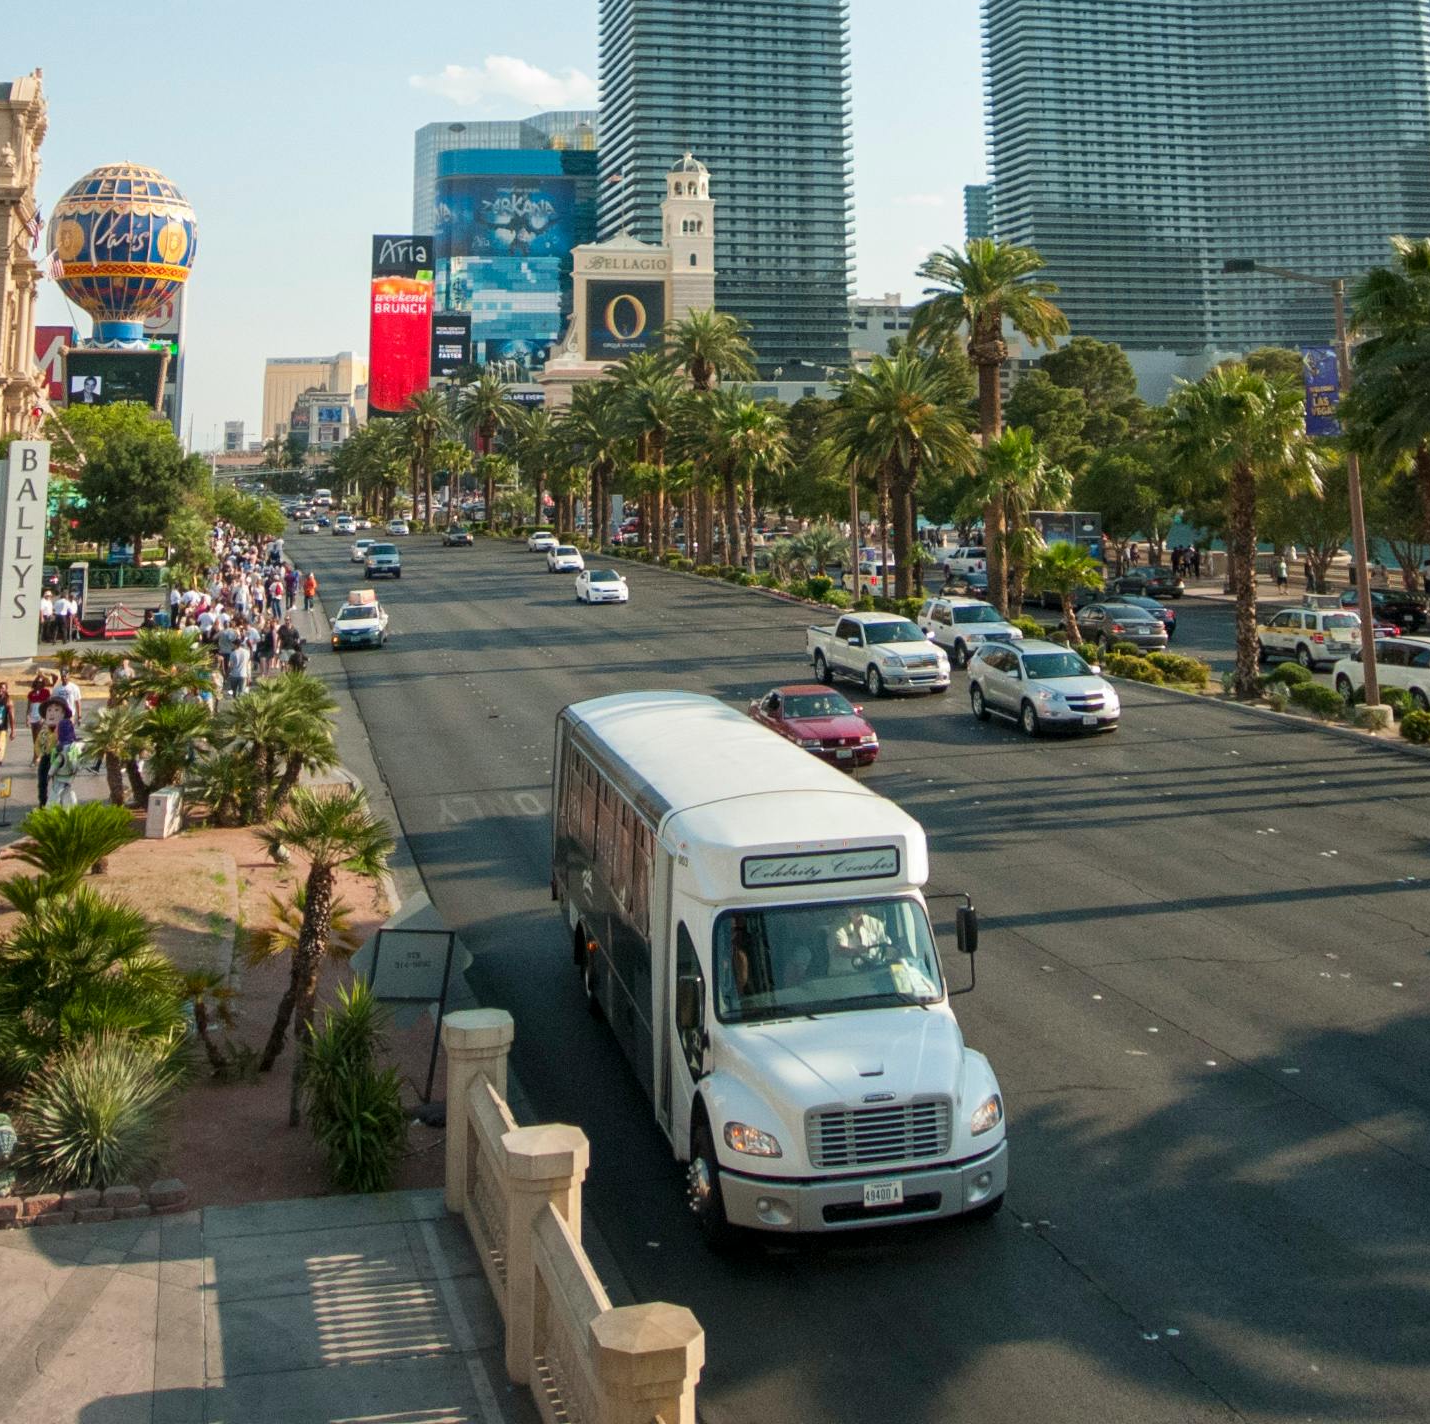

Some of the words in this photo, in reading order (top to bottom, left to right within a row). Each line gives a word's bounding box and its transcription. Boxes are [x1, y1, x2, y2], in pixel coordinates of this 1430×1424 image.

[90, 202, 150, 267] Paris
[379, 239, 427, 265] Aria
[585, 256, 668, 271] BELLAGIO
[374, 303, 428, 314] BRUNCH
[375, 290, 428, 303] weekend
[604, 294, 647, 340] O
[12, 448, 38, 619] BALLYS
[748, 862, 822, 880] Celebrity
[830, 855, 895, 874] Coaches
